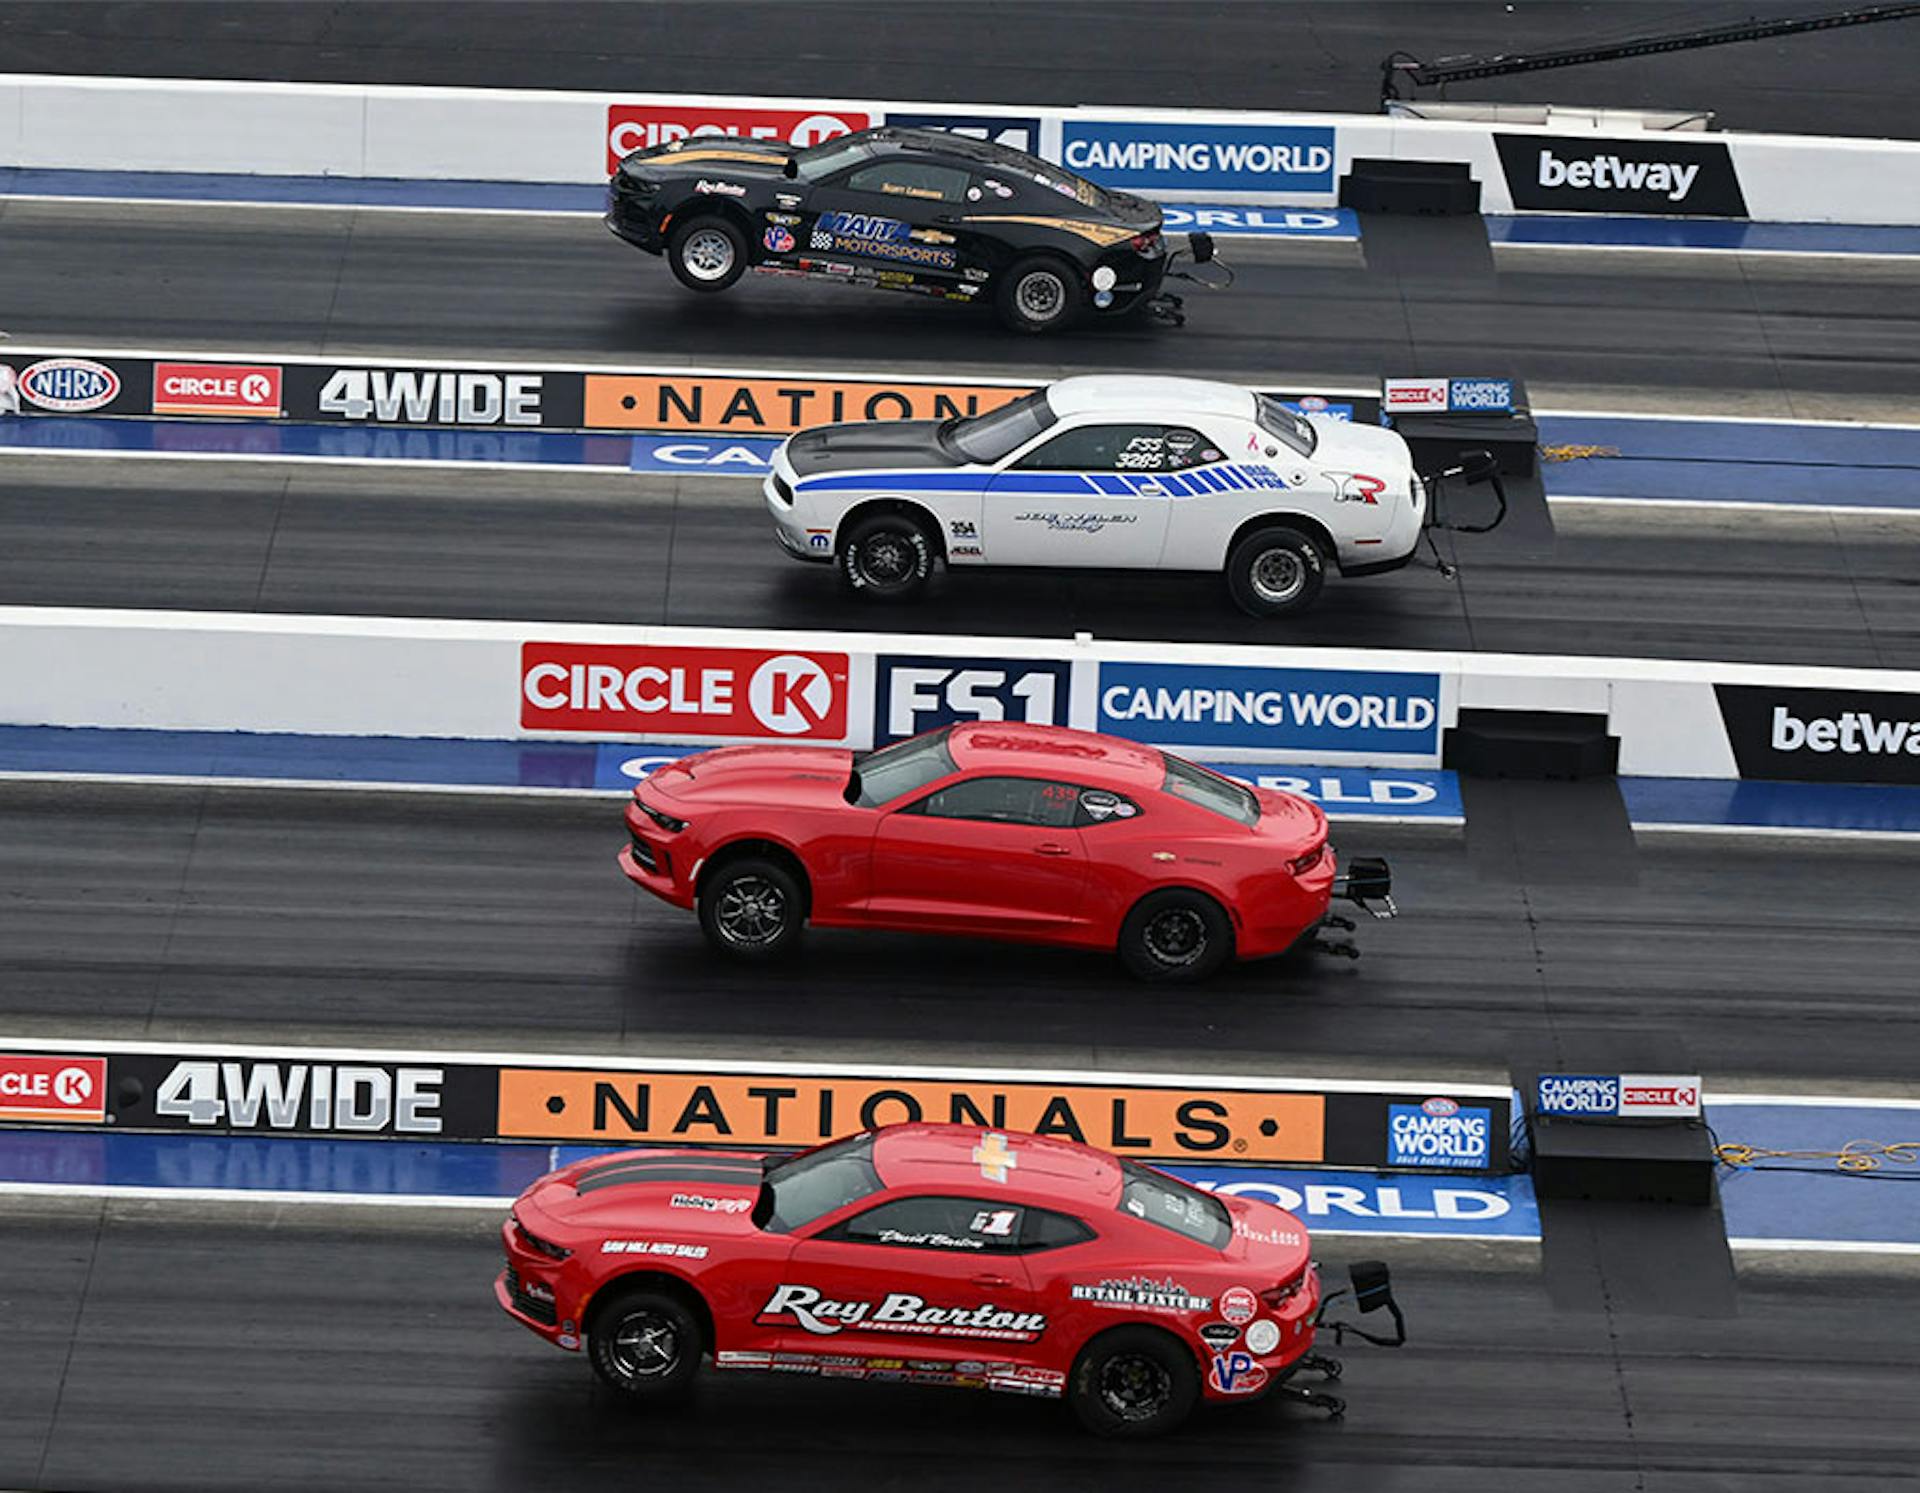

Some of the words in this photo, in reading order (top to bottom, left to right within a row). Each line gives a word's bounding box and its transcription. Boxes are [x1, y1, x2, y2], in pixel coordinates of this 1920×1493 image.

[1065, 141, 1209, 171] CAMPING
[1215, 146, 1331, 174] WORLD
[1539, 151, 1700, 201] betway
[1161, 207, 1340, 230] ORLD
[834, 236, 952, 266] MOTORSPORTS
[36, 370, 103, 398] NHRA
[163, 377, 237, 397] CIRCLE
[319, 369, 543, 425] 4WIDE
[1389, 390, 1424, 402] CIRCLE
[1452, 382, 1510, 395] CAMPING
[658, 385, 1024, 427] NATION
[1452, 393, 1510, 407] WORLD
[524, 663, 735, 716] CIRCLE
[888, 667, 1056, 736] FS1
[1102, 685, 1282, 725] CAMPING
[1288, 692, 1436, 730] WORLD
[156, 1061, 444, 1133] 4WIDE
[1539, 1078, 1616, 1095] CAMPING
[1624, 1091, 1672, 1104] CIRCLE
[593, 1082, 1231, 1152] NATIONALS
[1540, 1093, 1616, 1112] WORLD
[1392, 1114, 1486, 1137] CAMPING
[1393, 1133, 1486, 1157] WORLD
[1196, 1182, 1511, 1219] ORLD
[763, 1284, 872, 1335] Ray
[871, 1293, 1047, 1331] Barton
[1072, 1285, 1134, 1302] RETAIL
[1137, 1289, 1213, 1313] FIXTURE
[1213, 1352, 1254, 1391] VP
